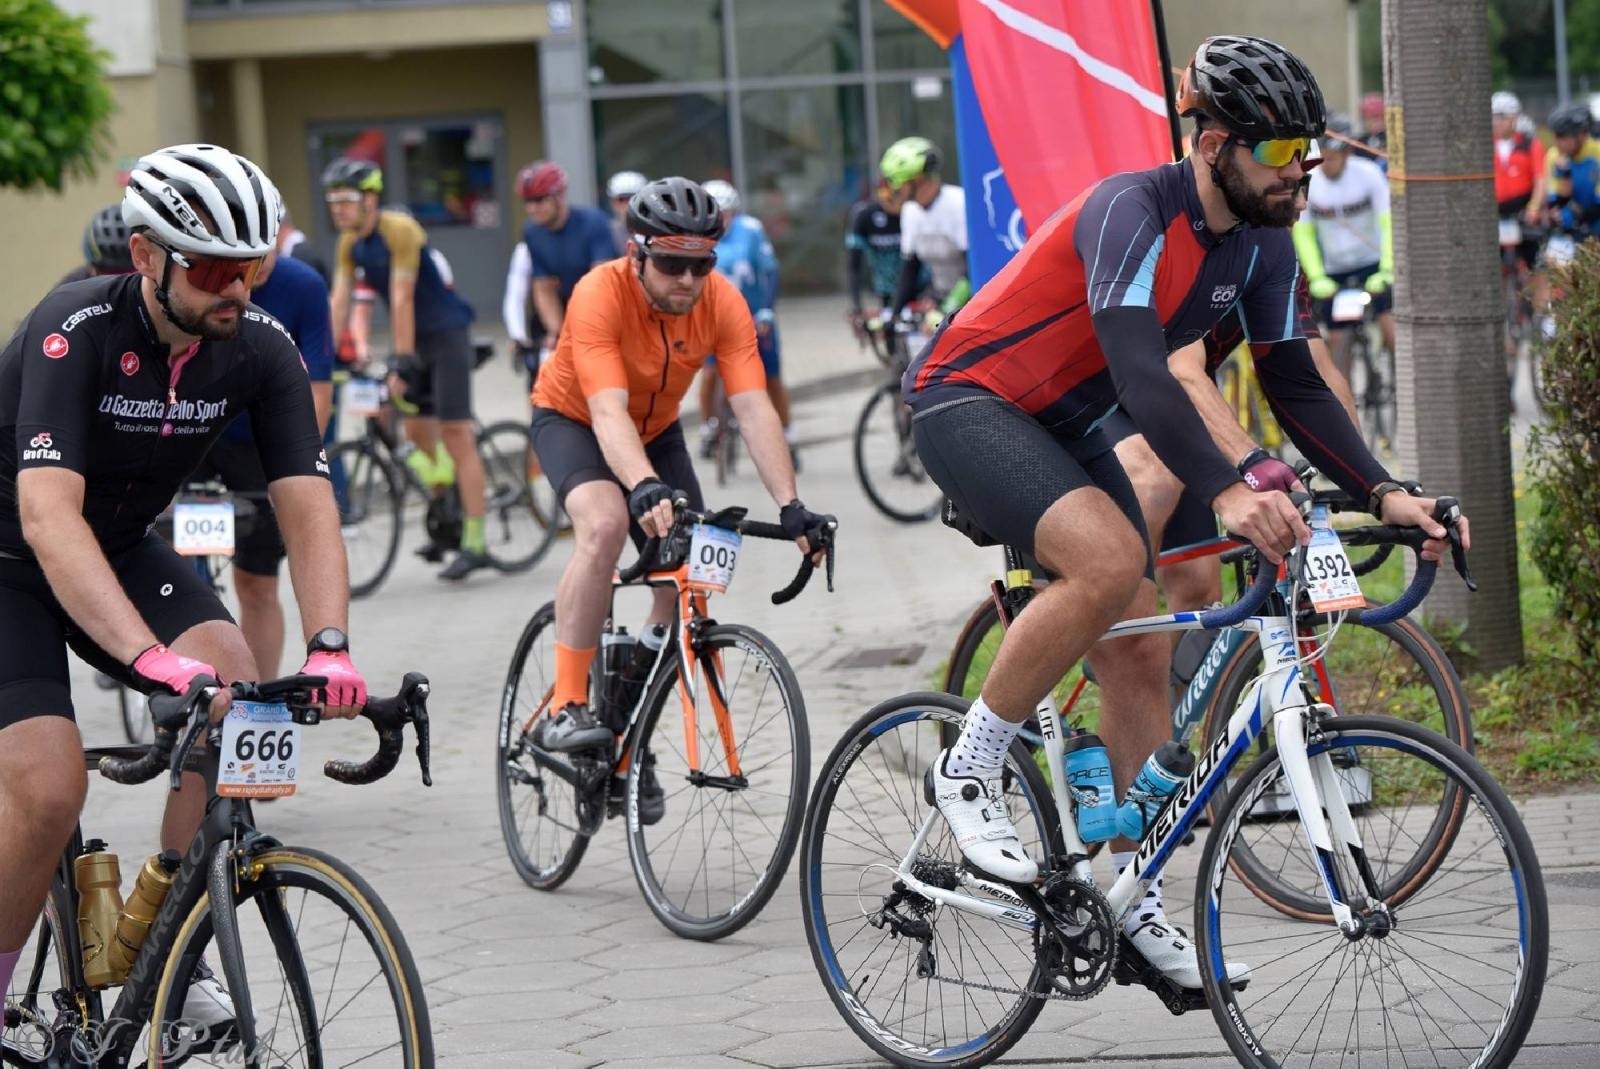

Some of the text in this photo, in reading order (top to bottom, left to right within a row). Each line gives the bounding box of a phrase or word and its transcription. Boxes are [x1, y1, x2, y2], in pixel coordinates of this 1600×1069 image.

[111, 394, 165, 419] Gazzetta
[194, 398, 228, 423] Sport
[185, 519, 225, 536] 004
[700, 544, 737, 571] 003
[1303, 553, 1352, 581] 1392
[253, 704, 281, 714] GRAND
[1038, 707, 1056, 742] LITE
[235, 729, 294, 762] 666
[1066, 766, 1110, 785] ORCE
[1133, 724, 1230, 878] MERIDA
[979, 883, 1031, 911] MERIDA
[1227, 1002, 1263, 1056] ALEXRIMS
